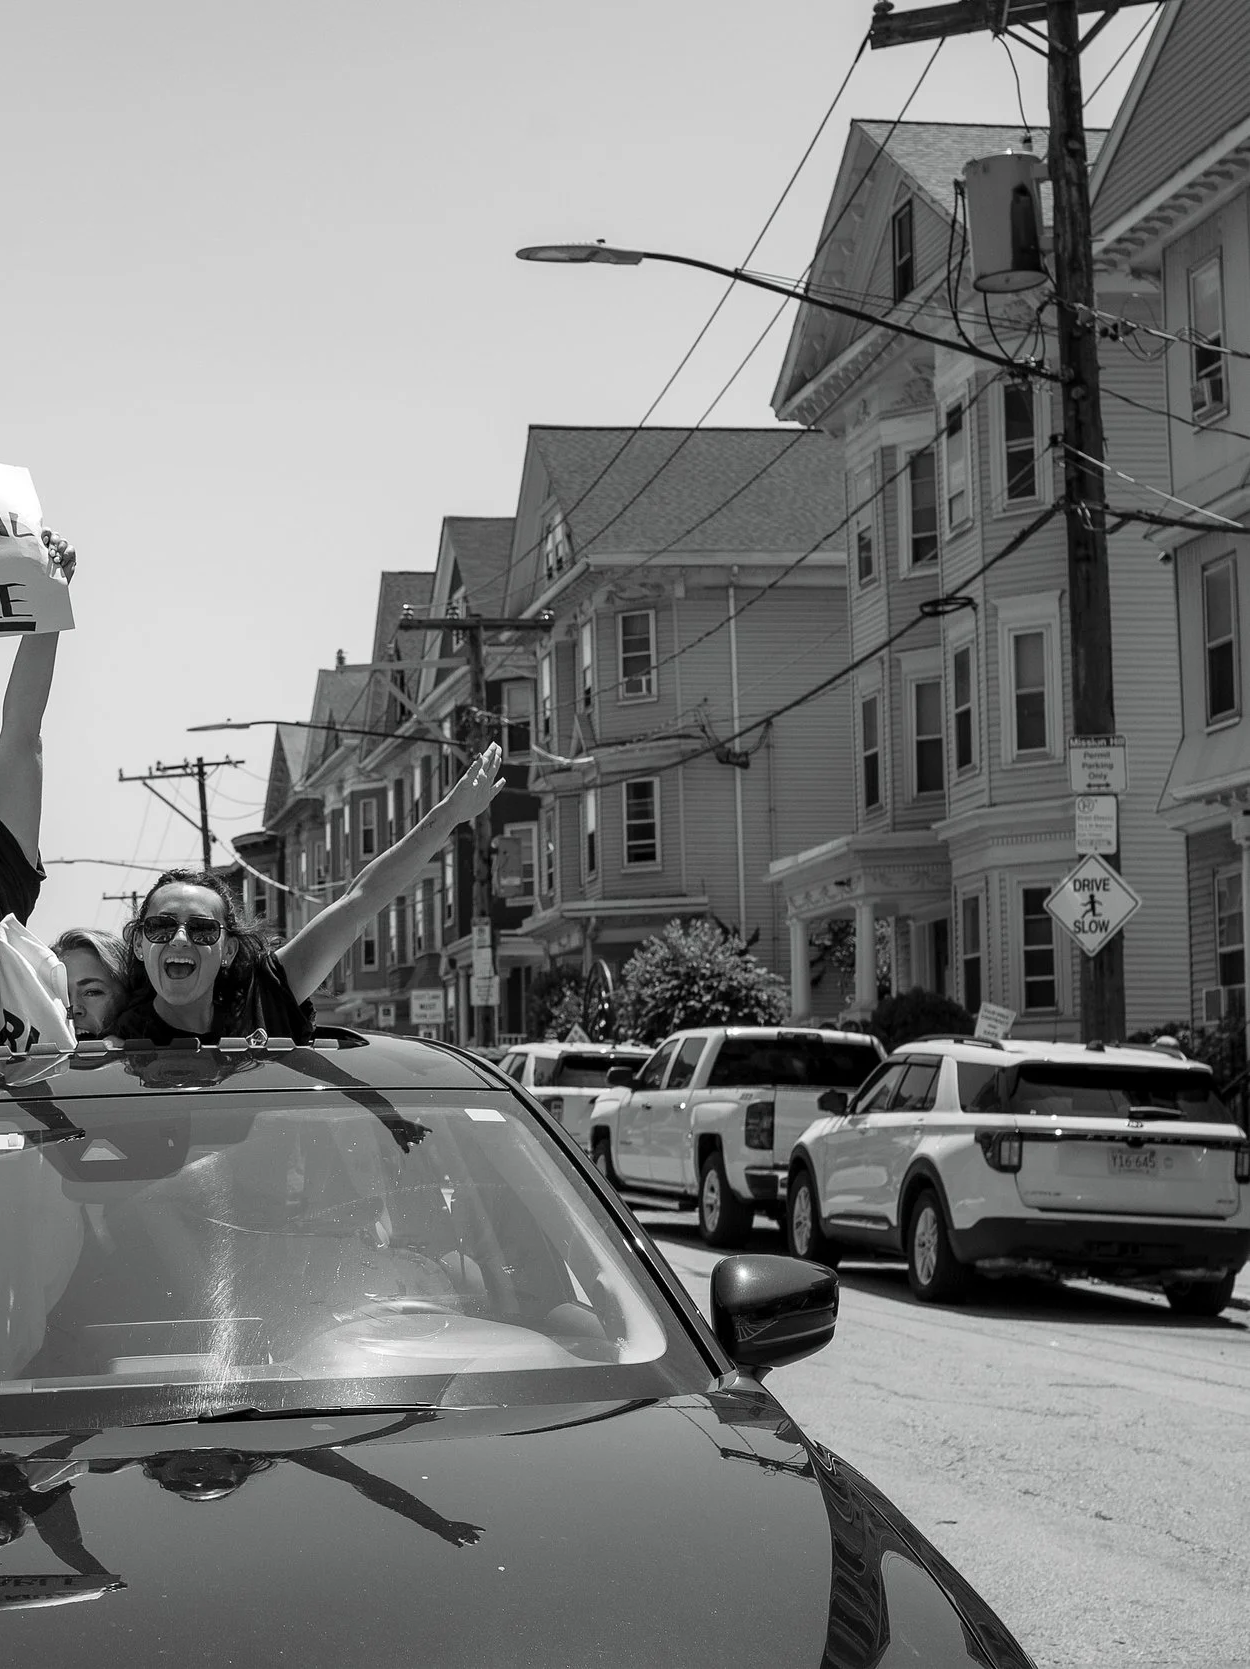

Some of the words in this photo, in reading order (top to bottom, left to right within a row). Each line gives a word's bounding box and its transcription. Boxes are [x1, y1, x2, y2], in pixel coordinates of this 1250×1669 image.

[1082, 762, 1114, 770] Parking
[1073, 878, 1110, 892] DRIVE
[1073, 920, 1110, 934] SLOW
